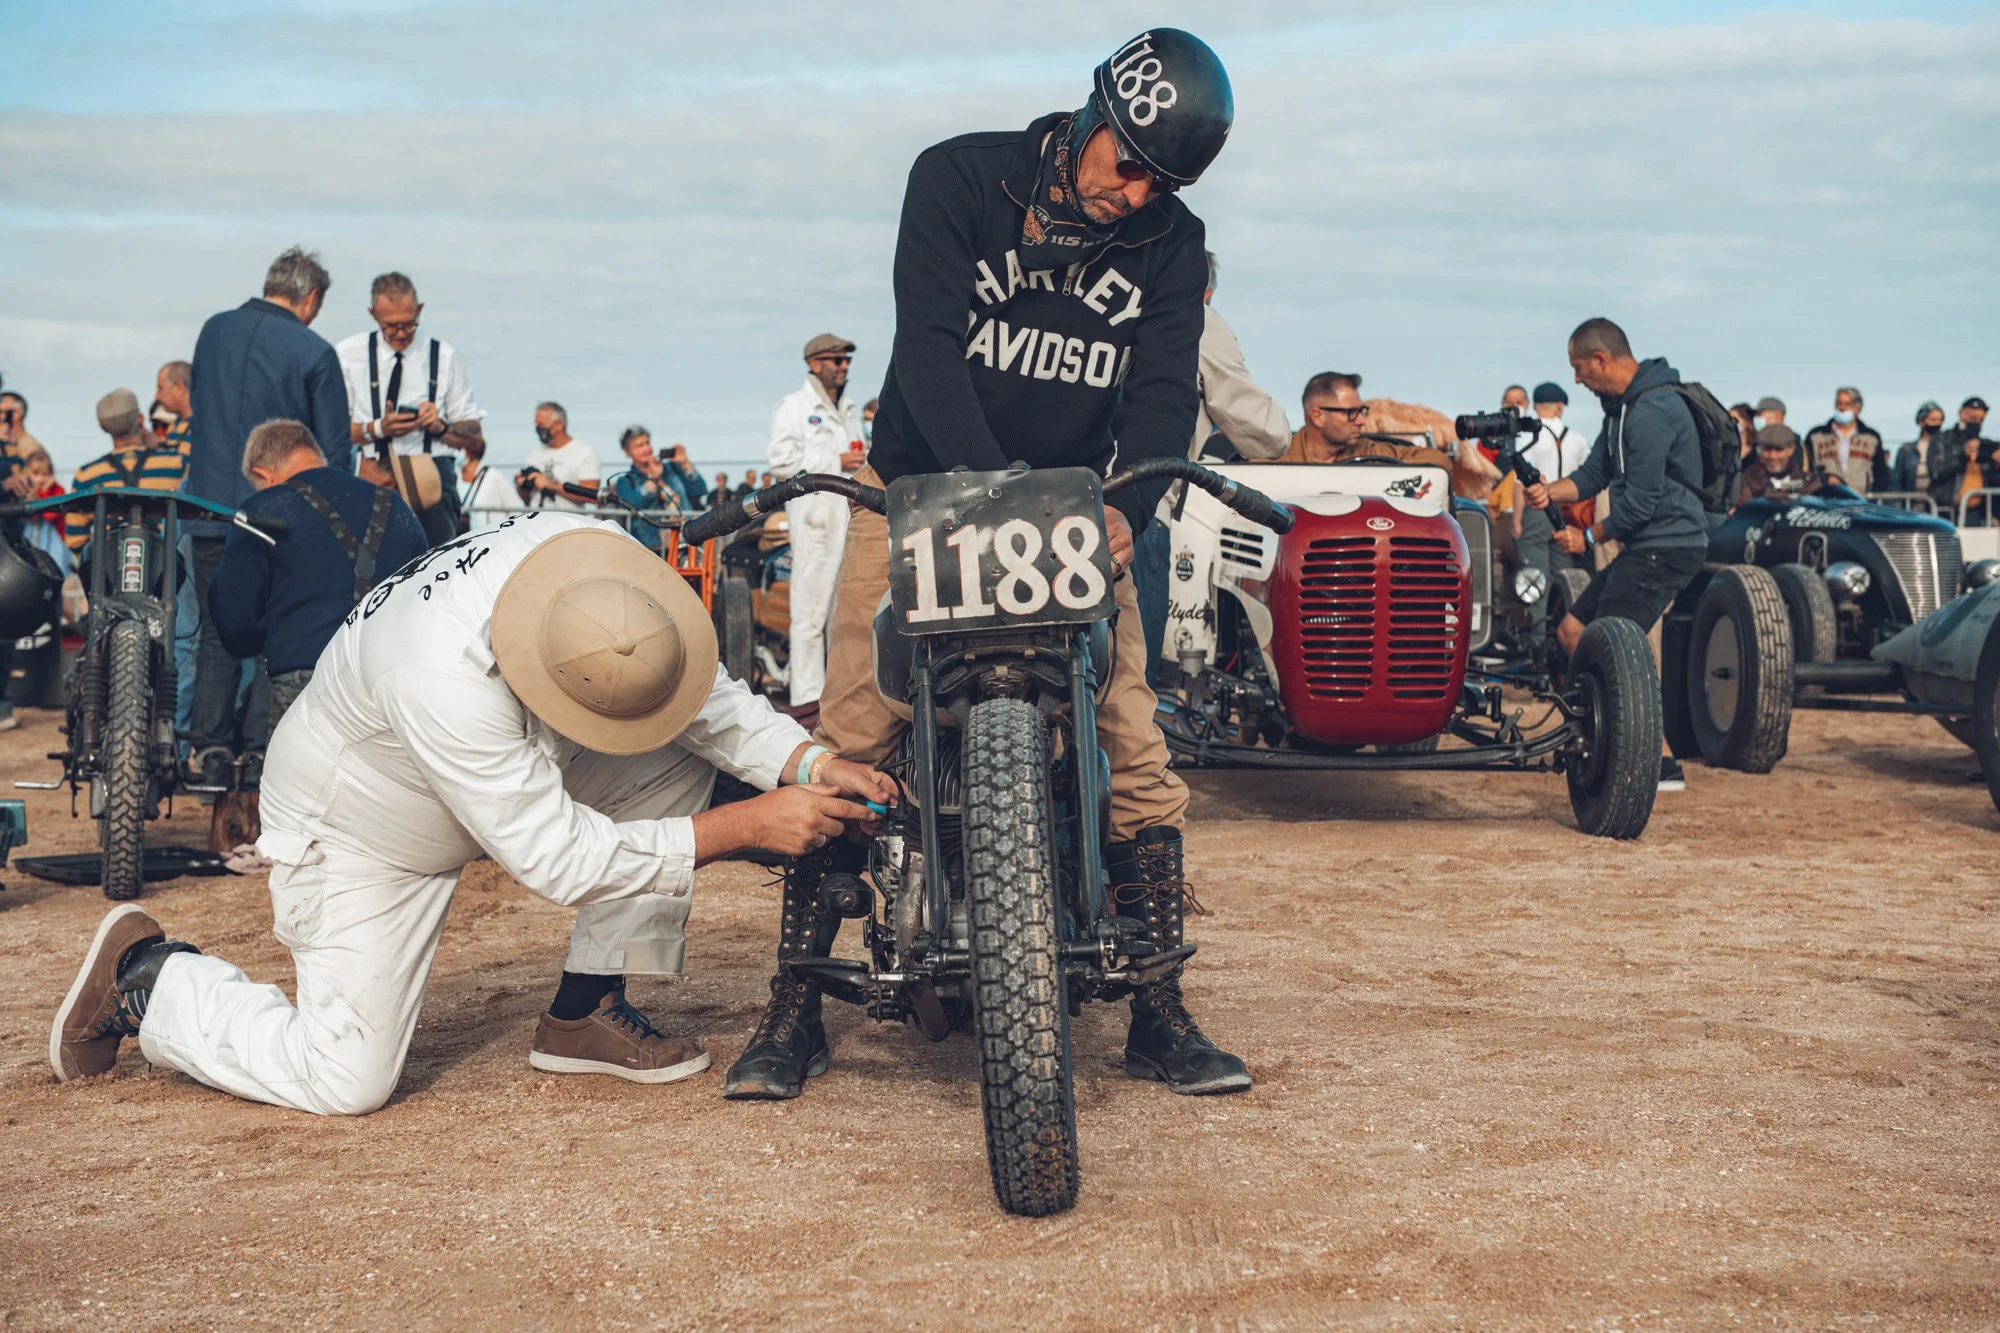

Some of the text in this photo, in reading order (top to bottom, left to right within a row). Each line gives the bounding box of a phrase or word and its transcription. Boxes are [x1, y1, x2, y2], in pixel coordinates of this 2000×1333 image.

[1110, 32, 1177, 127] 1188
[1050, 235, 1082, 247] 115
[965, 309, 1132, 388] AVIDSO
[902, 515, 1107, 623] 1188
